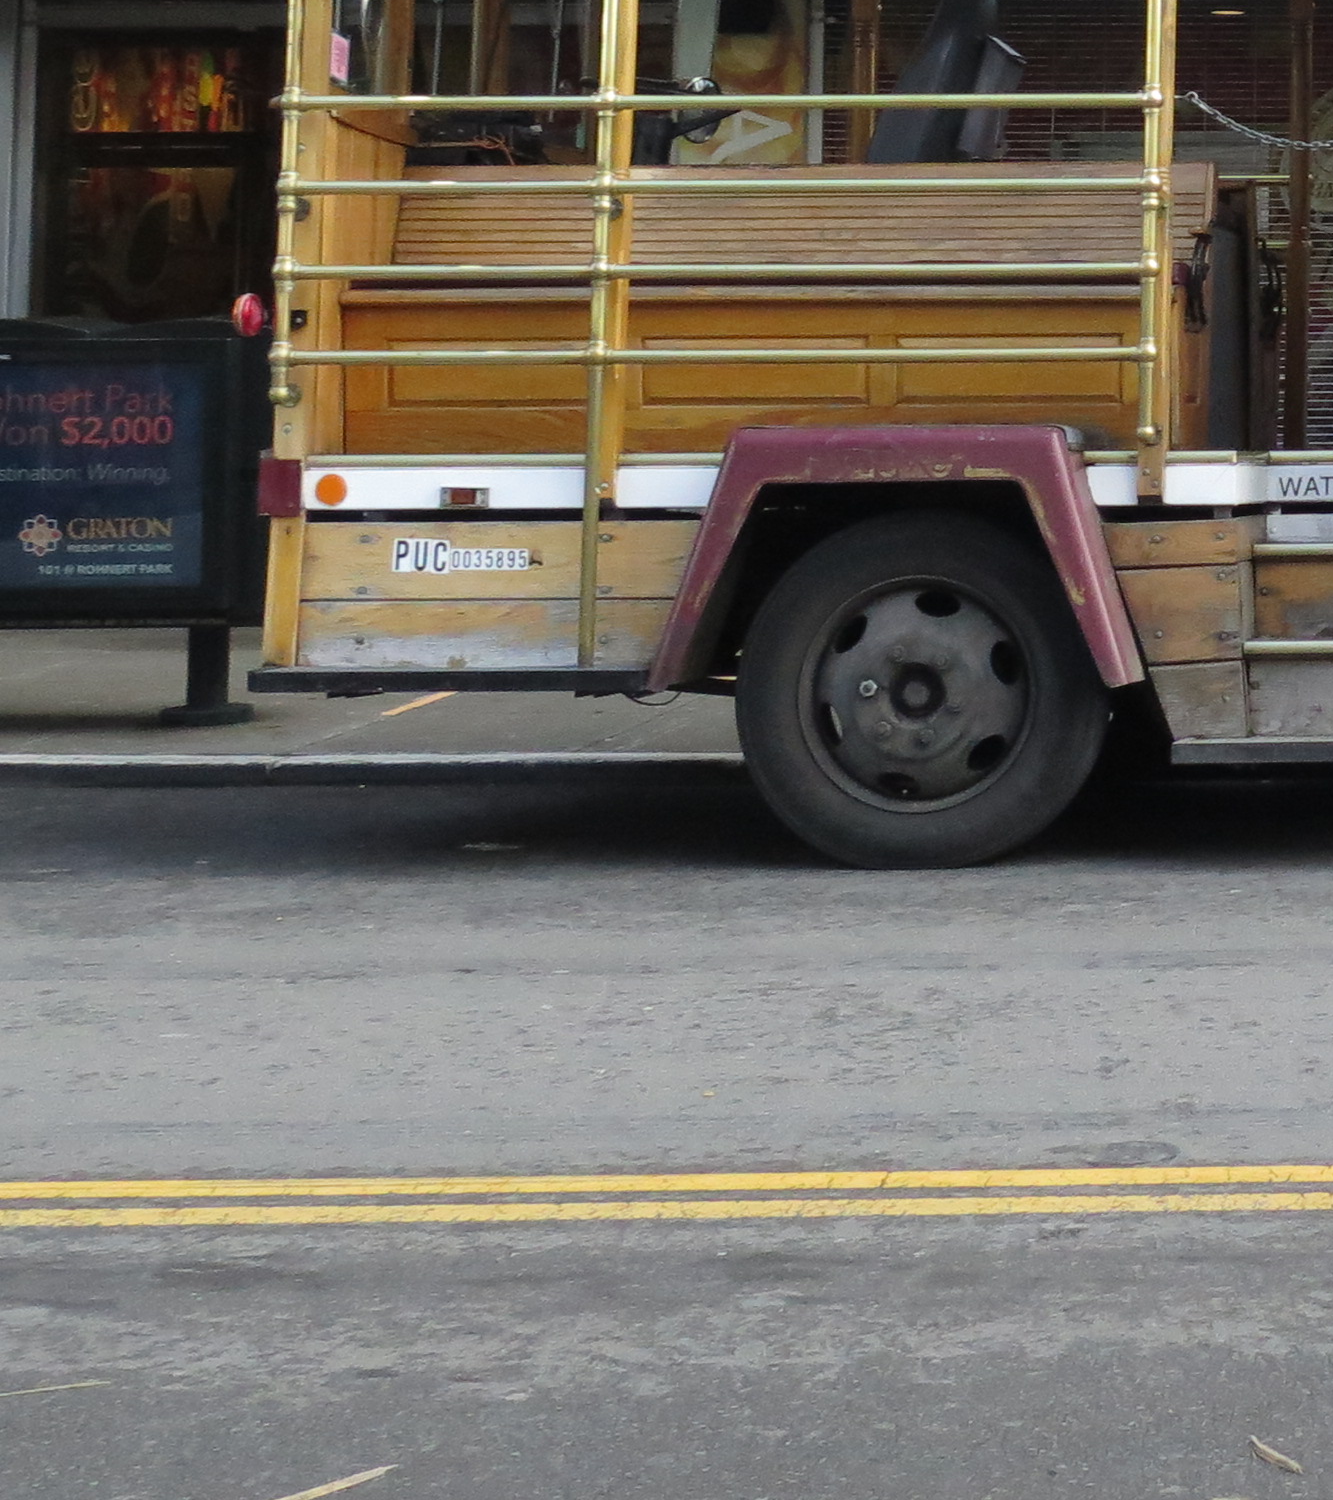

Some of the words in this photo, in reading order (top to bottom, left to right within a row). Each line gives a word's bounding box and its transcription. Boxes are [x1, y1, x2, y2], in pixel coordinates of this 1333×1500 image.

[106, 384, 173, 413] Park
[67, 516, 174, 540] GRATON
[394, 540, 448, 572] PUC
[451, 550, 527, 568] 0035895
